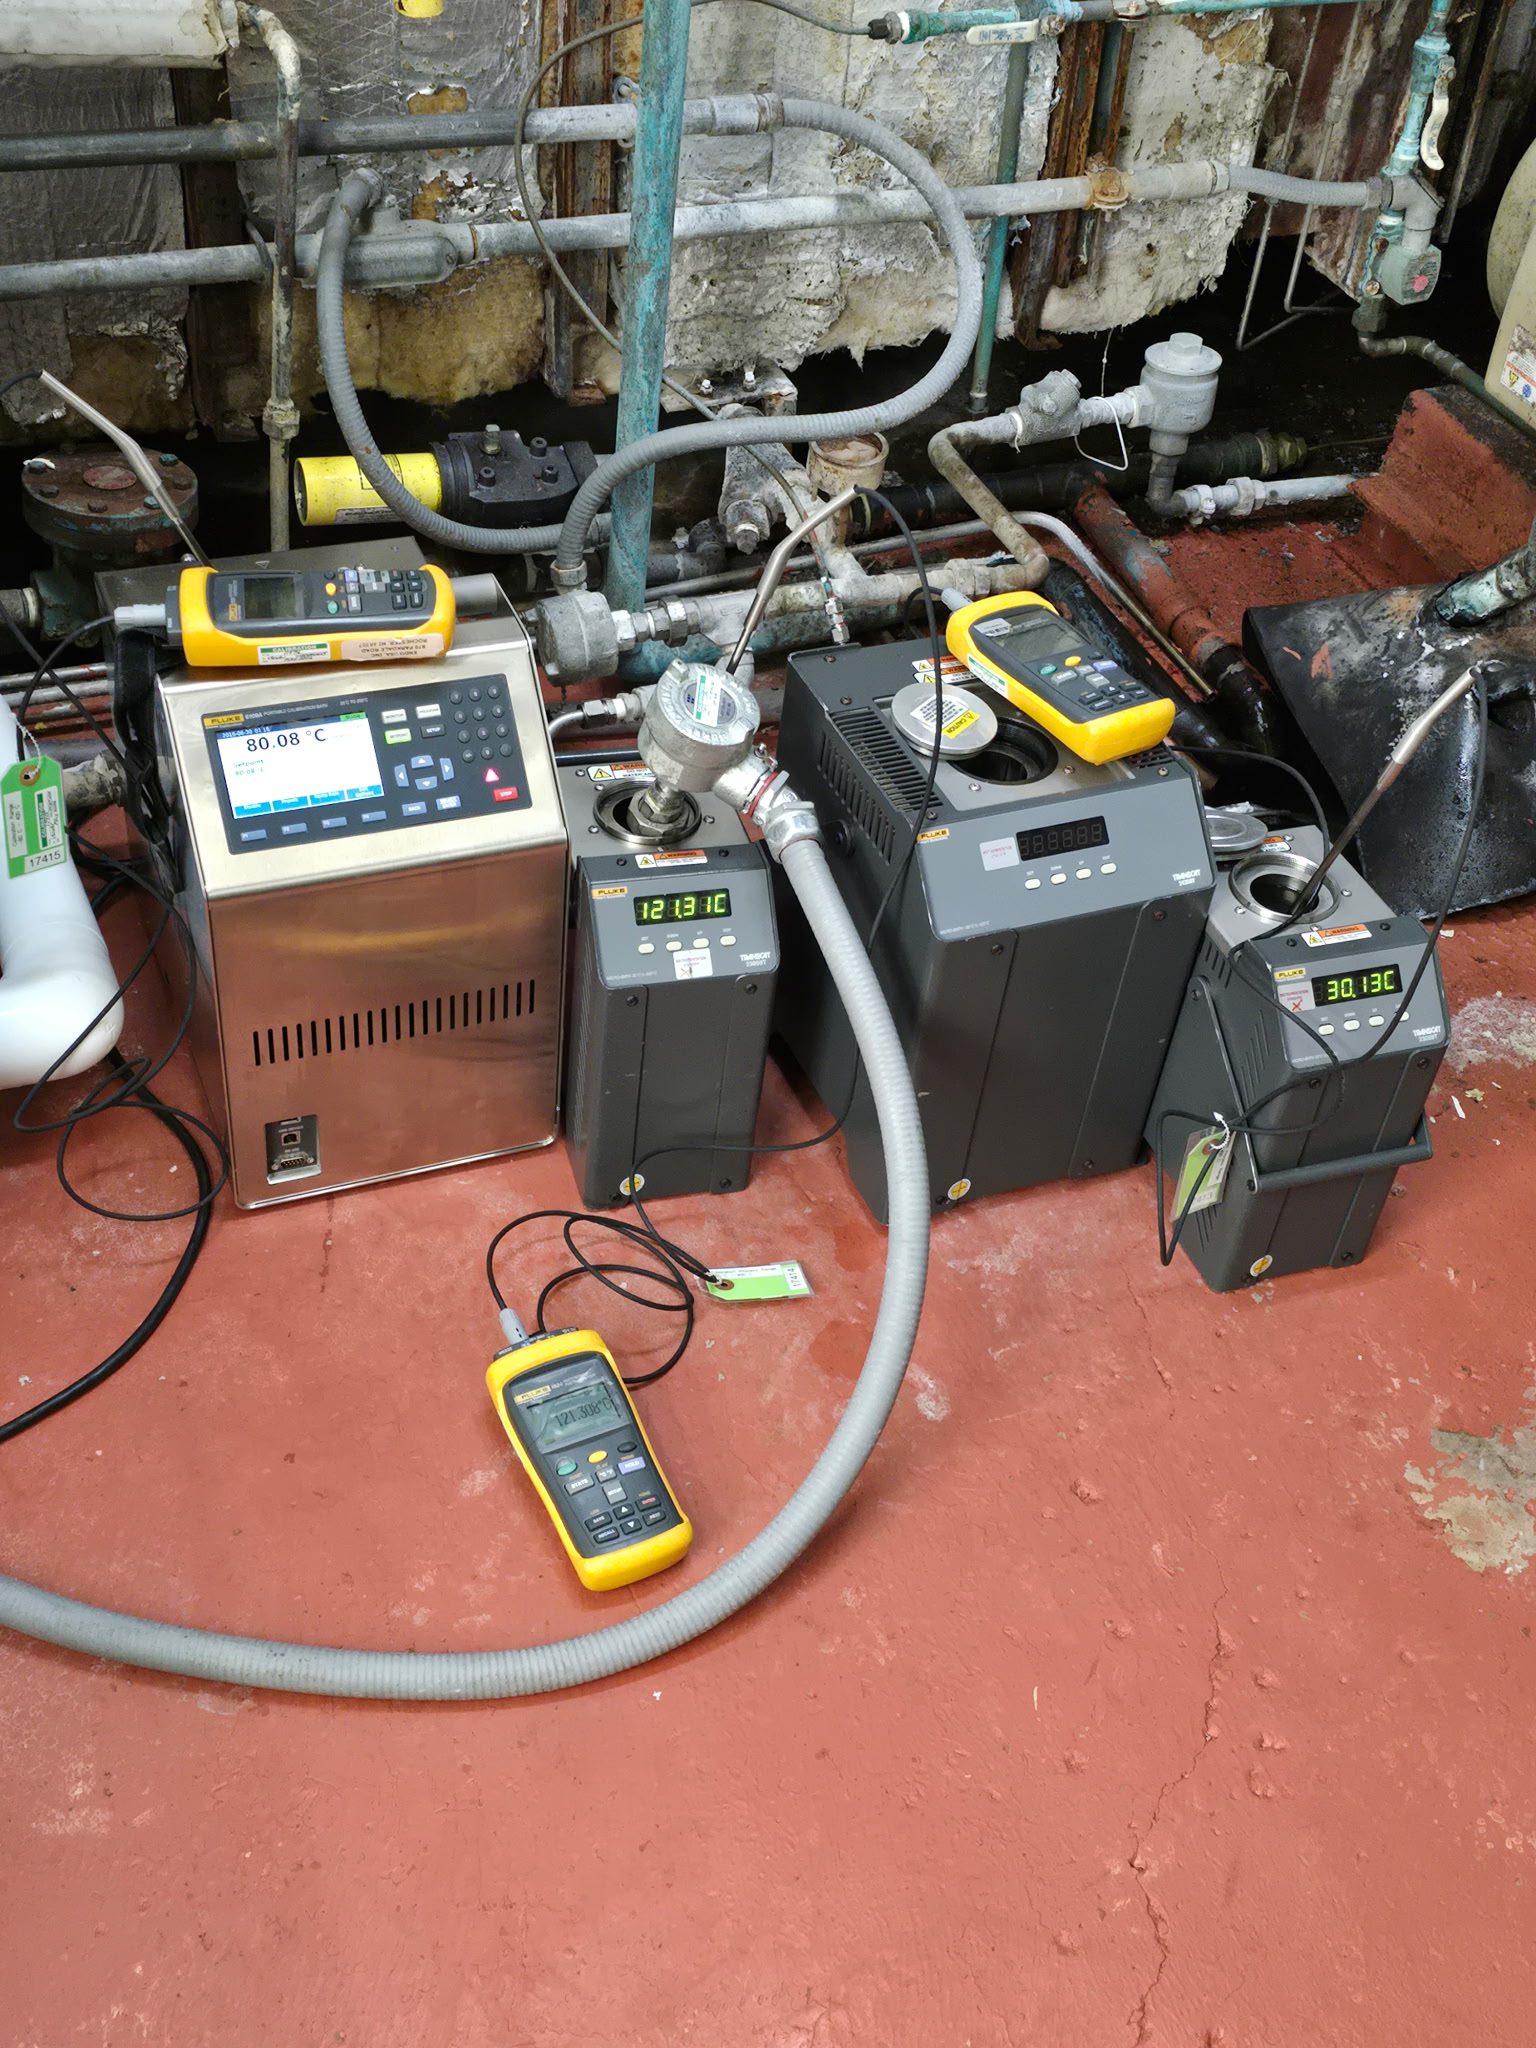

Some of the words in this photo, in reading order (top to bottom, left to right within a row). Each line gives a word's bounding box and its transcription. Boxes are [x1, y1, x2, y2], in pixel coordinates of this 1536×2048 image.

[272, 644, 316, 653] CALIBRATION
[211, 716, 241, 724] FLUKE
[946, 718, 967, 734] CAUTION
[246, 732, 300, 752] 80.08
[306, 729, 326, 742] °C
[920, 830, 948, 840] FLUKE
[30, 850, 61, 867] 17415
[598, 888, 625, 896] FLUKE
[1332, 926, 1360, 935] WARNING
[1278, 969, 1304, 978] FLUKE
[1327, 970, 1394, 1001] 30.13C
[521, 1388, 549, 1400] FLUKE
[624, 1461, 641, 1469] HOLD
